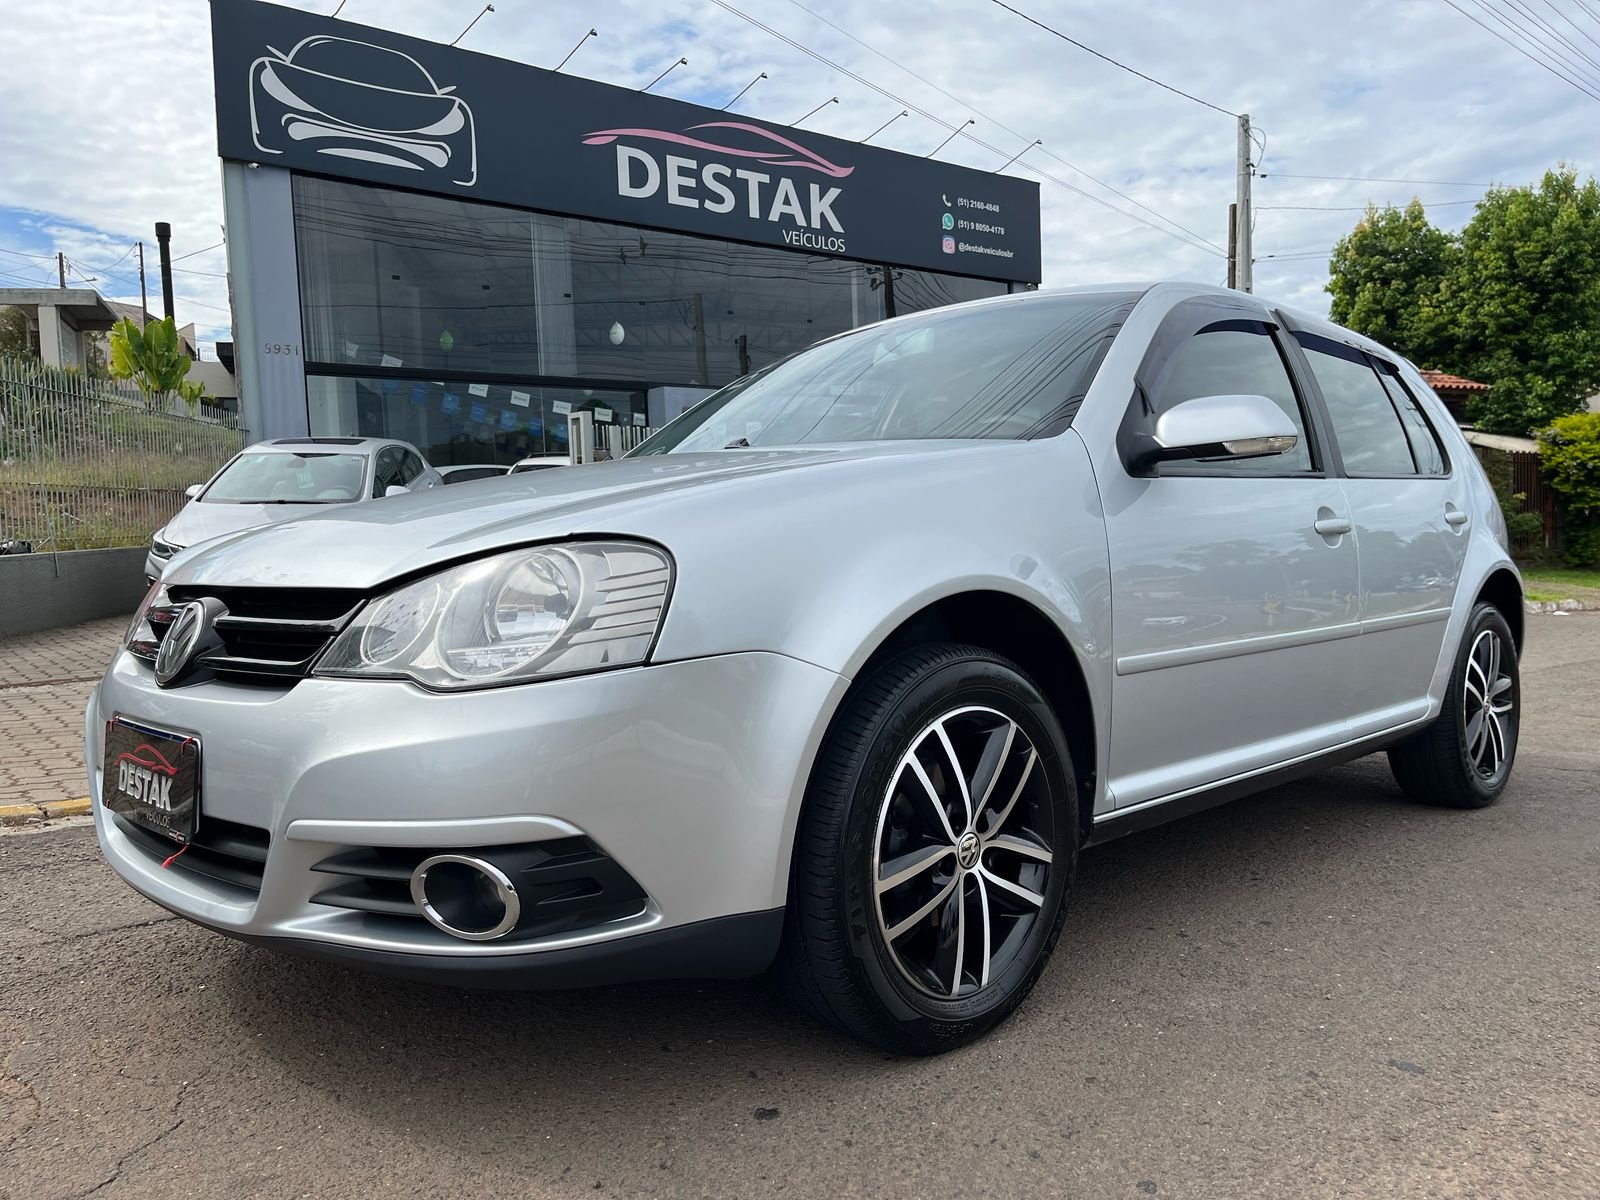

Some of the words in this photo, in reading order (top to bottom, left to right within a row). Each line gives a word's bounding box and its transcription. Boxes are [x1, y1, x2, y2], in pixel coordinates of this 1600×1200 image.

[616, 144, 845, 234] DESTAK
[957, 197, 969, 208] (51)
[957, 219, 969, 231] (51)
[970, 222, 975, 230] 9
[782, 229, 846, 252] VEÍCULOS
[118, 759, 173, 812] DESTAK
